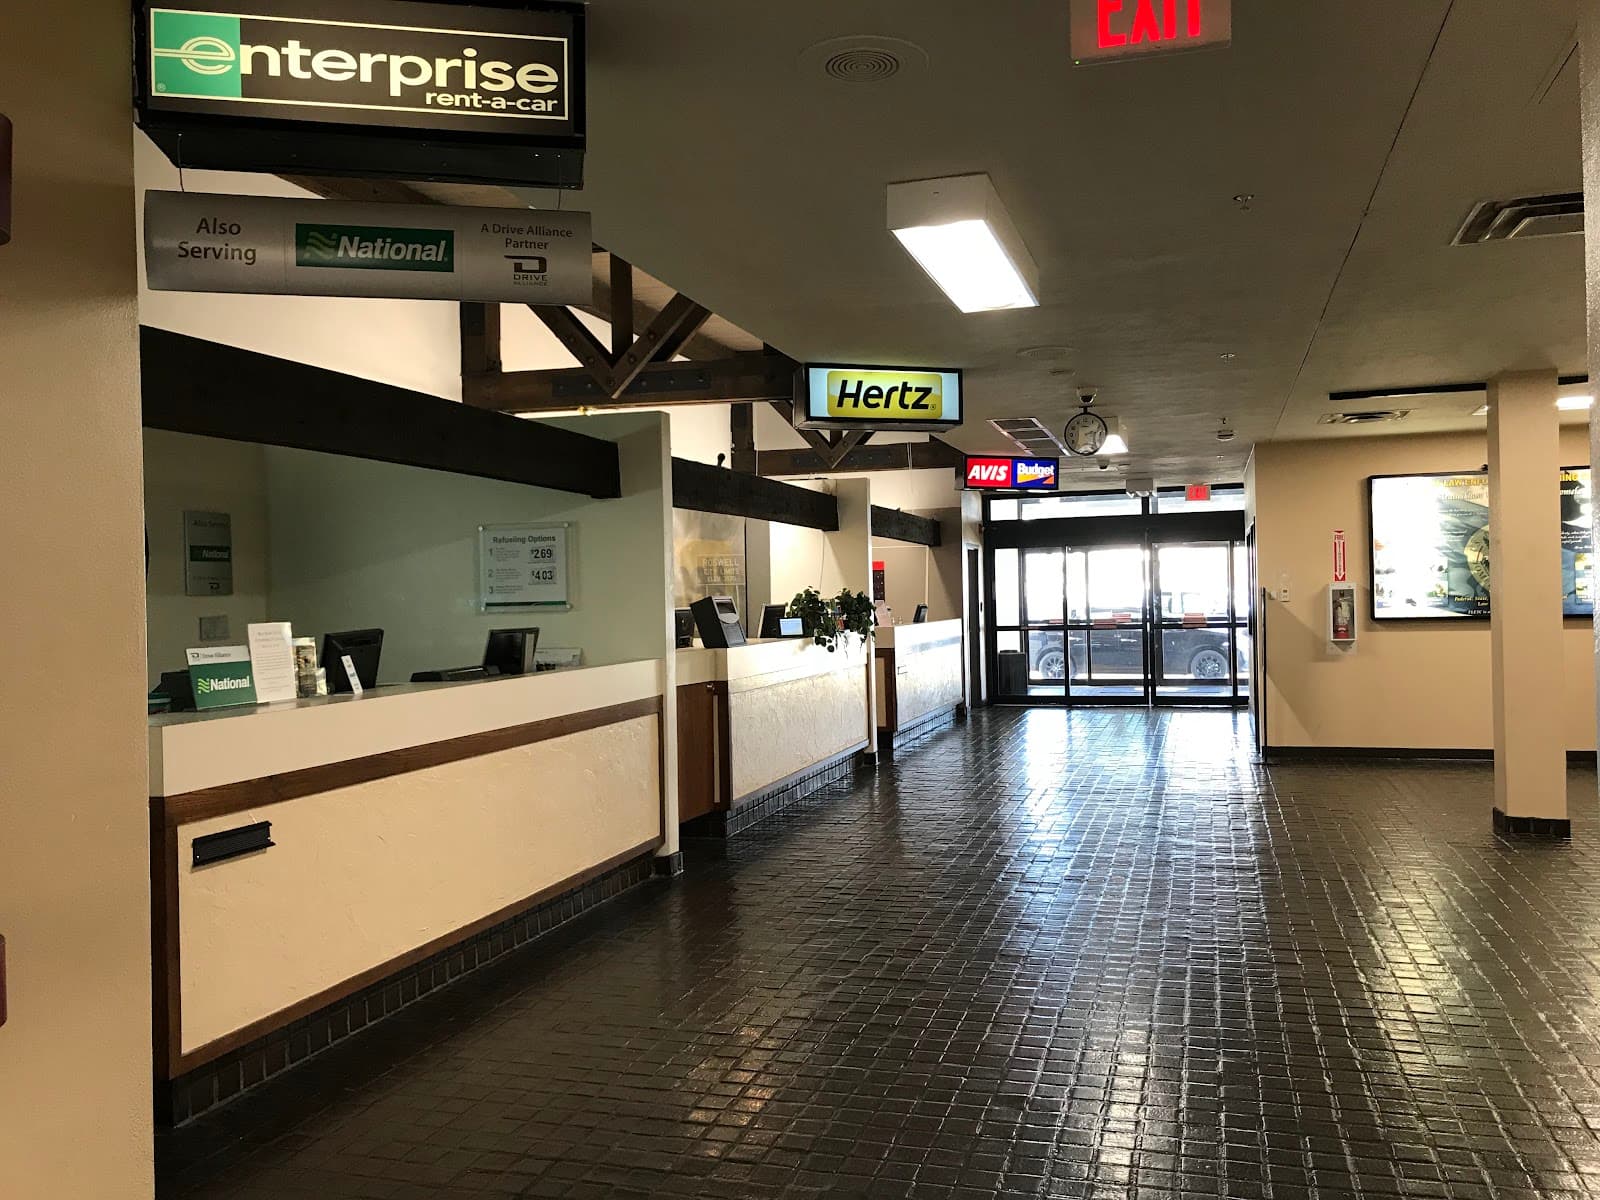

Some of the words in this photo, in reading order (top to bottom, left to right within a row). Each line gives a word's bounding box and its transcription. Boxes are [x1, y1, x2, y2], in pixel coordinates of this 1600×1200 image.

[180, 36, 559, 97] enterprise
[425, 92, 558, 112] rent-a-car
[196, 217, 242, 236] Also
[480, 223, 490, 233] A
[492, 223, 525, 236] Drive
[526, 225, 573, 238] Alliance
[177, 241, 257, 266] Serving
[336, 236, 447, 262] National
[505, 238, 549, 250] Partner
[513, 274, 549, 282] DRIVE
[836, 379, 933, 410] Hertz
[968, 464, 1008, 481] AVIS
[1017, 462, 1055, 479] Budget
[528, 535, 556, 543] Options
[703, 558, 740, 567] ROSWELL
[210, 675, 250, 692] National
